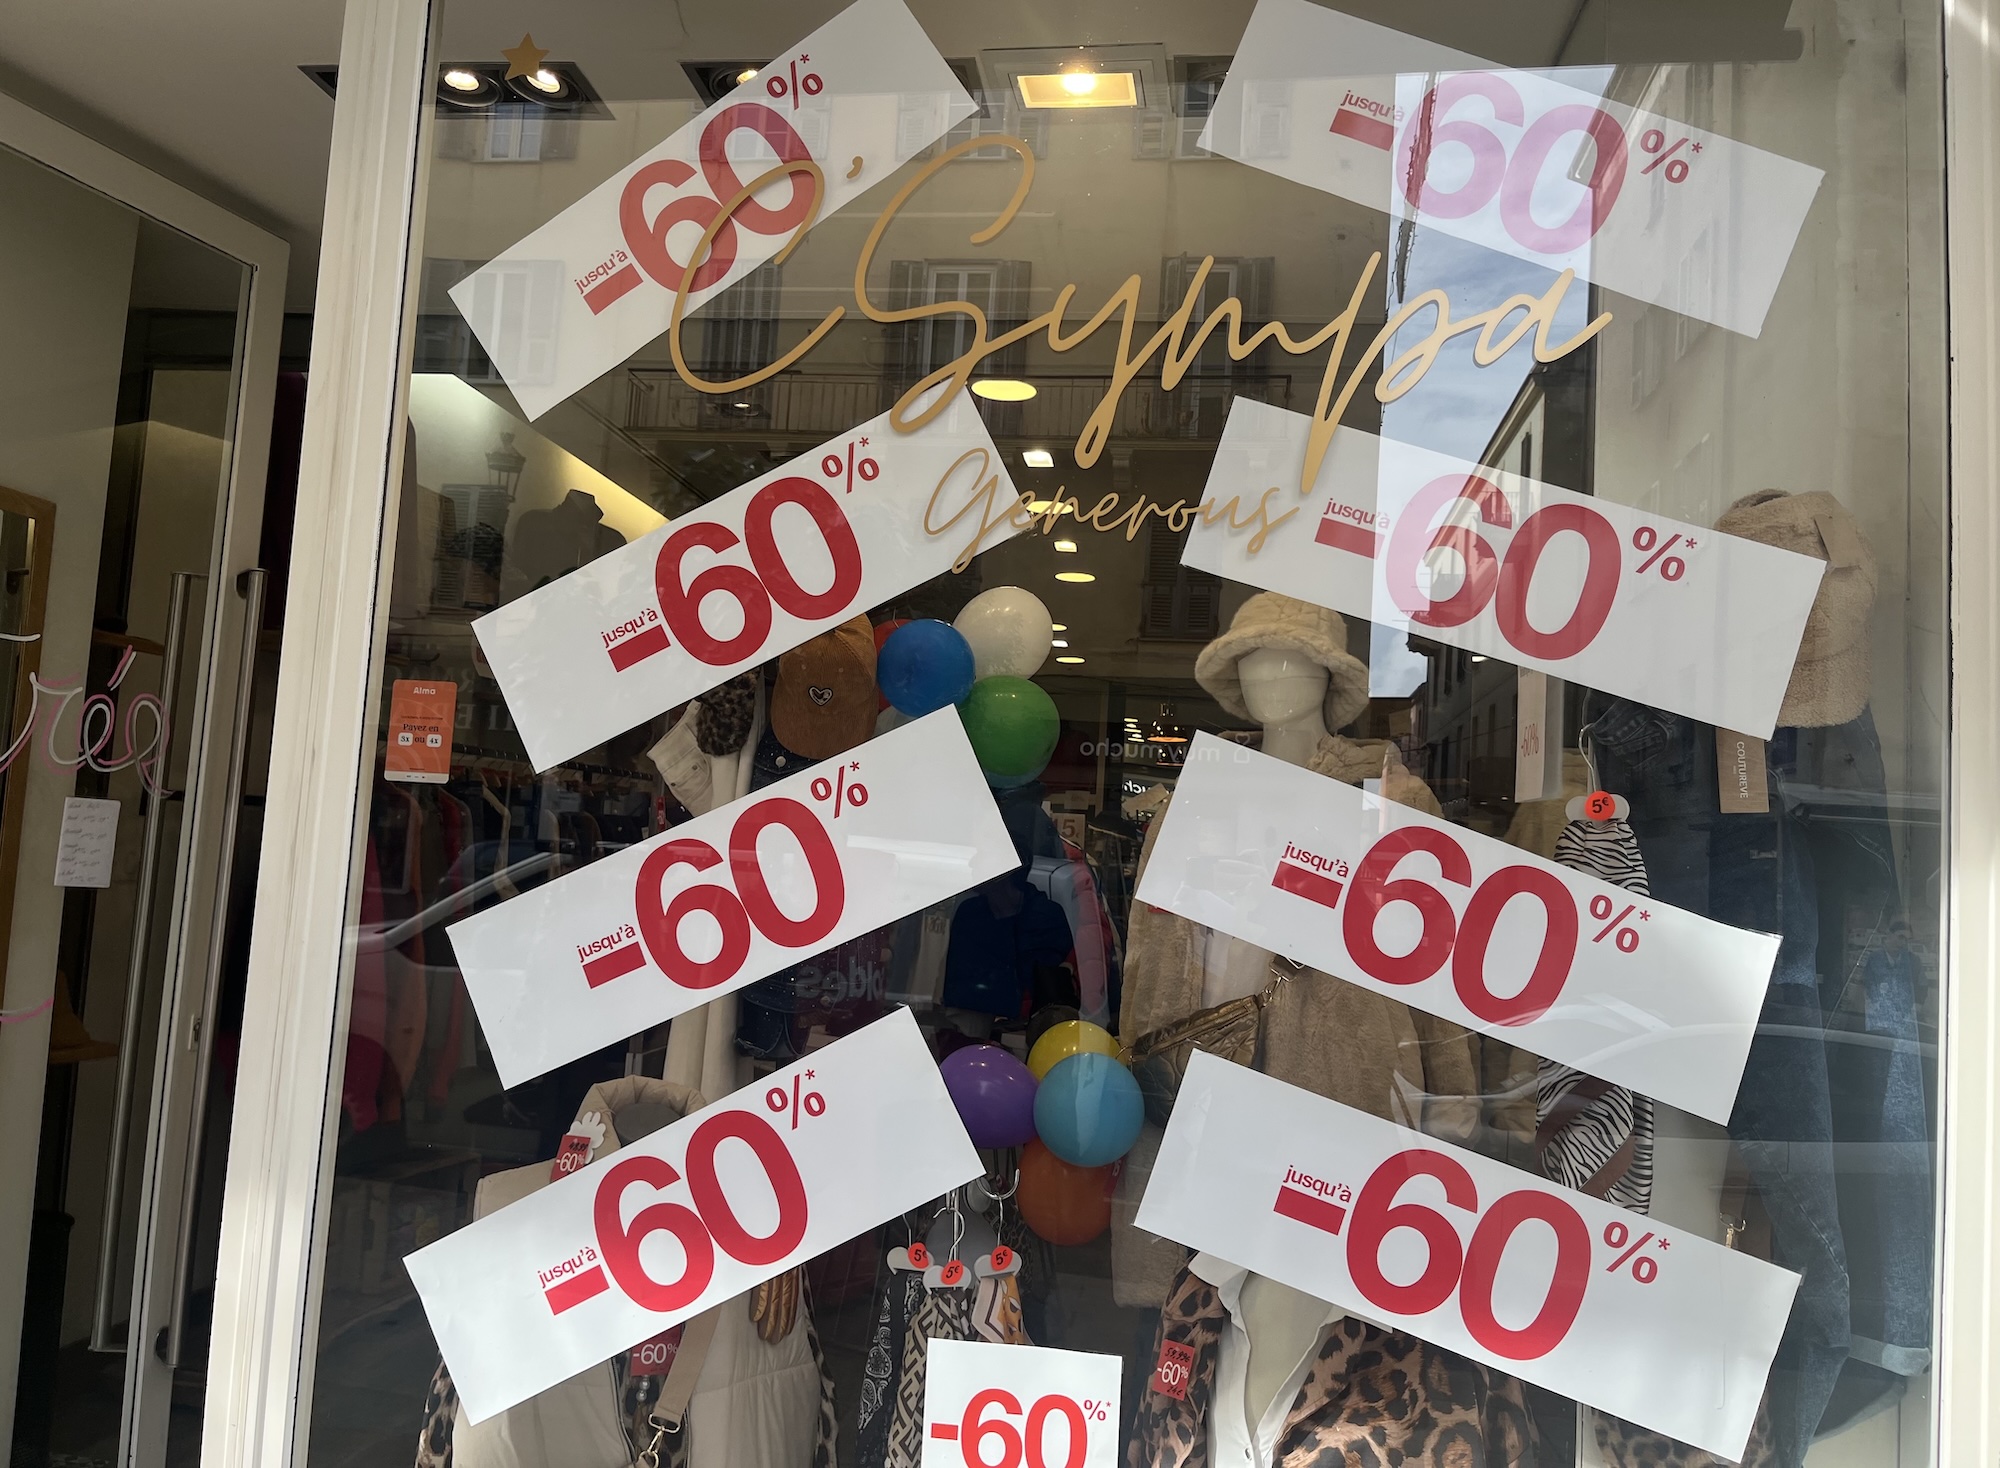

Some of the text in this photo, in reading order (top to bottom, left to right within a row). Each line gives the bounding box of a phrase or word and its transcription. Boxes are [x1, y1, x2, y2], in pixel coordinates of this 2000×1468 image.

[1339, 89, 1405, 123] jusqu'à
[573, 249, 630, 295] jusqu'à
[923, 447, 1301, 575] Generous
[1322, 496, 1391, 530] jusqu'à
[600, 607, 659, 649] jusqu'à
[412, 686, 437, 696] Alma
[400, 735, 439, 745] 3x ou 4x
[402, 723, 440, 733] Payez en
[1736, 741, 1749, 799] COUTUREVE
[1591, 795, 1610, 815] 5€
[1280, 840, 1350, 879] jusqu'à
[576, 923, 637, 963] jusqu'à
[555, 1151, 586, 1172] -60%
[1282, 1164, 1353, 1204] jusqu'à
[536, 1246, 598, 1289] jusqu'à
[913, 1248, 927, 1262] 5€
[995, 1251, 1009, 1266] 5€
[946, 1265, 960, 1279] 5€
[632, 1342, 679, 1365] -60%
[1156, 1360, 1189, 1386] -60%
